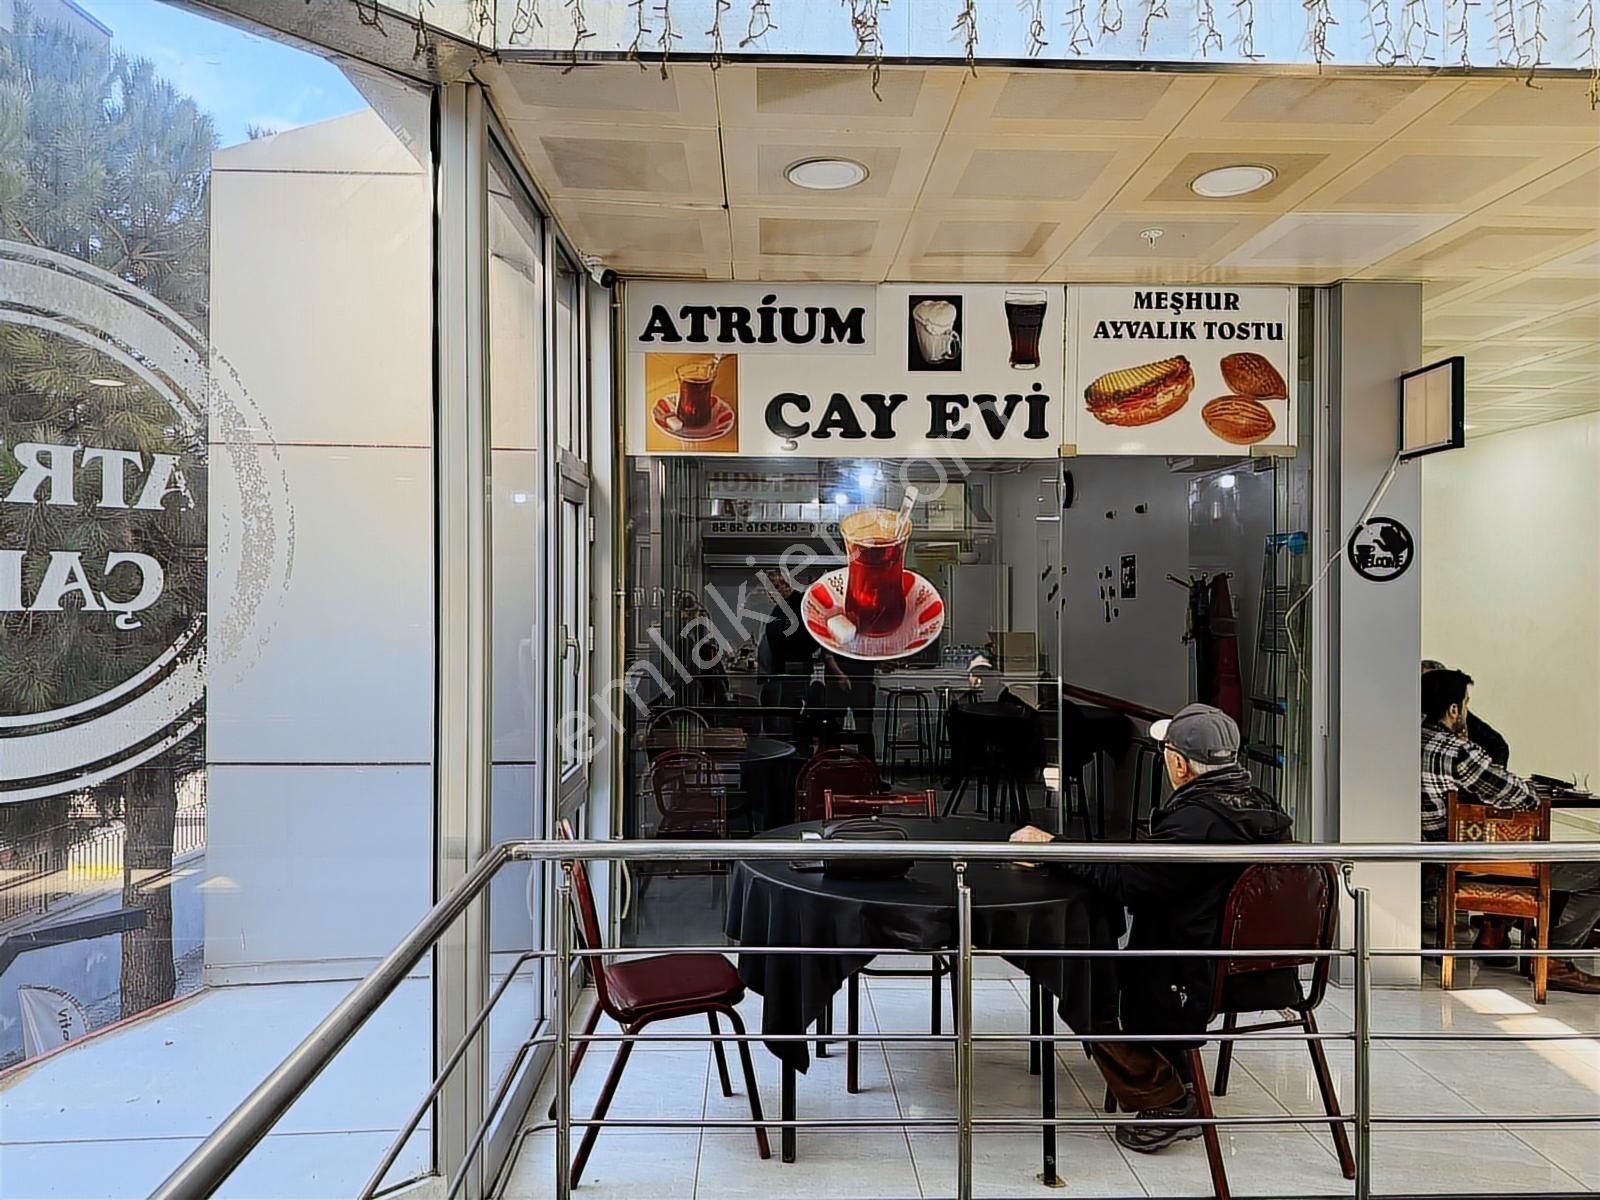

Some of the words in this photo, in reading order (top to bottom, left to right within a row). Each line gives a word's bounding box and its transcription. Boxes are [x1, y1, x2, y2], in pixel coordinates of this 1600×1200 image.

[637, 294, 866, 345] ATRİUM
[1133, 291, 1240, 315] MEŞHUR
[1093, 321, 1197, 340] AYVALIK
[1203, 321, 1283, 341] TOSTU
[764, 392, 908, 451] ÇAY
[925, 382, 1050, 440] EVİ
